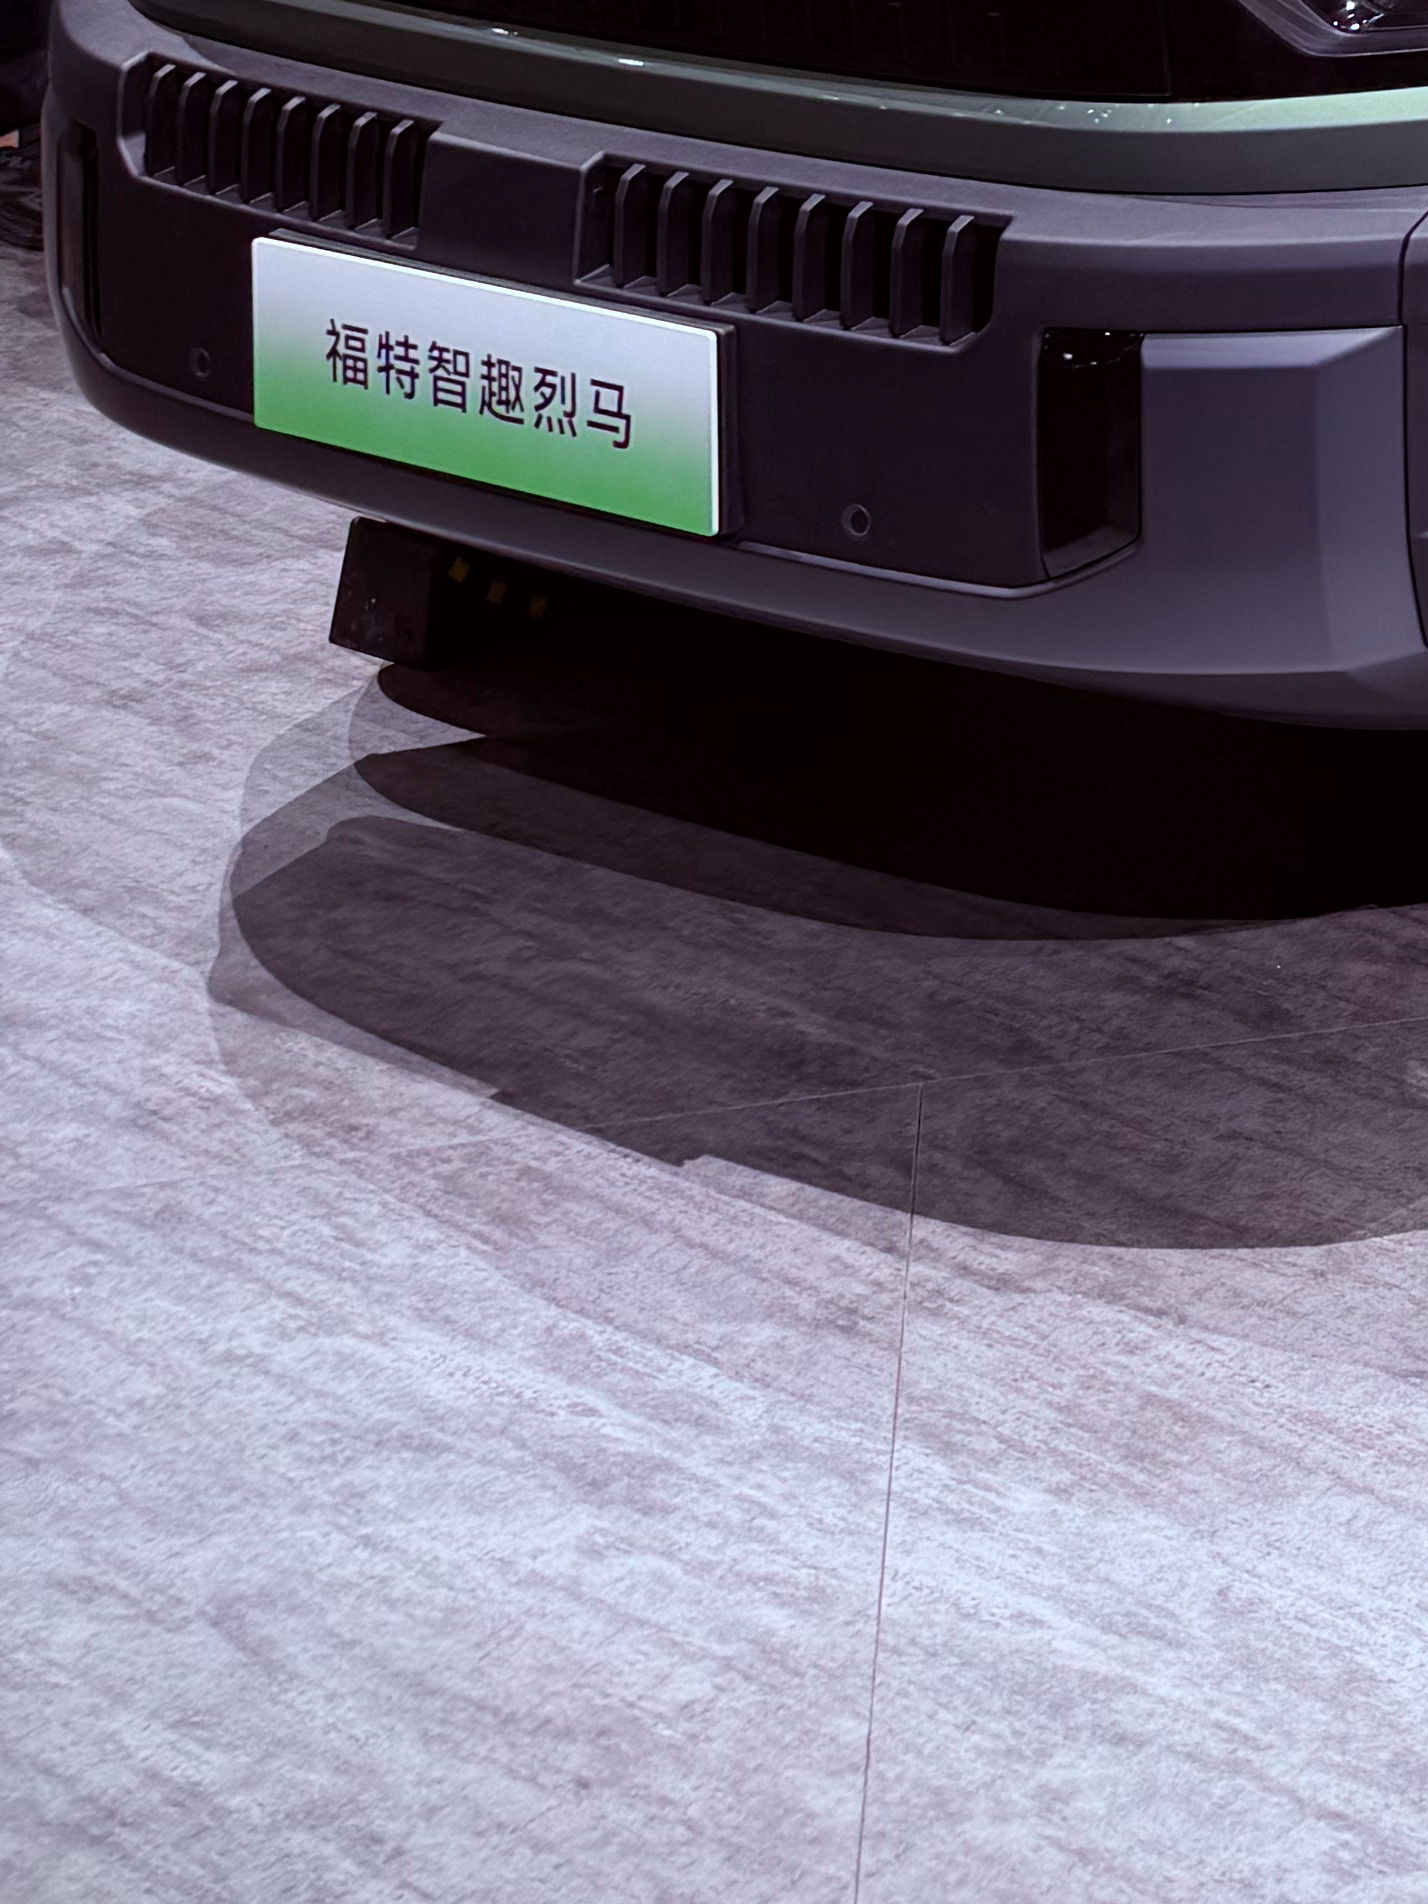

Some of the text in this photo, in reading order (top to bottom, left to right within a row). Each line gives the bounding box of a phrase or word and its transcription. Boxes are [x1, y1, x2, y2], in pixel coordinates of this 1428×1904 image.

[325, 318, 632, 450] 福特智趣烈马
